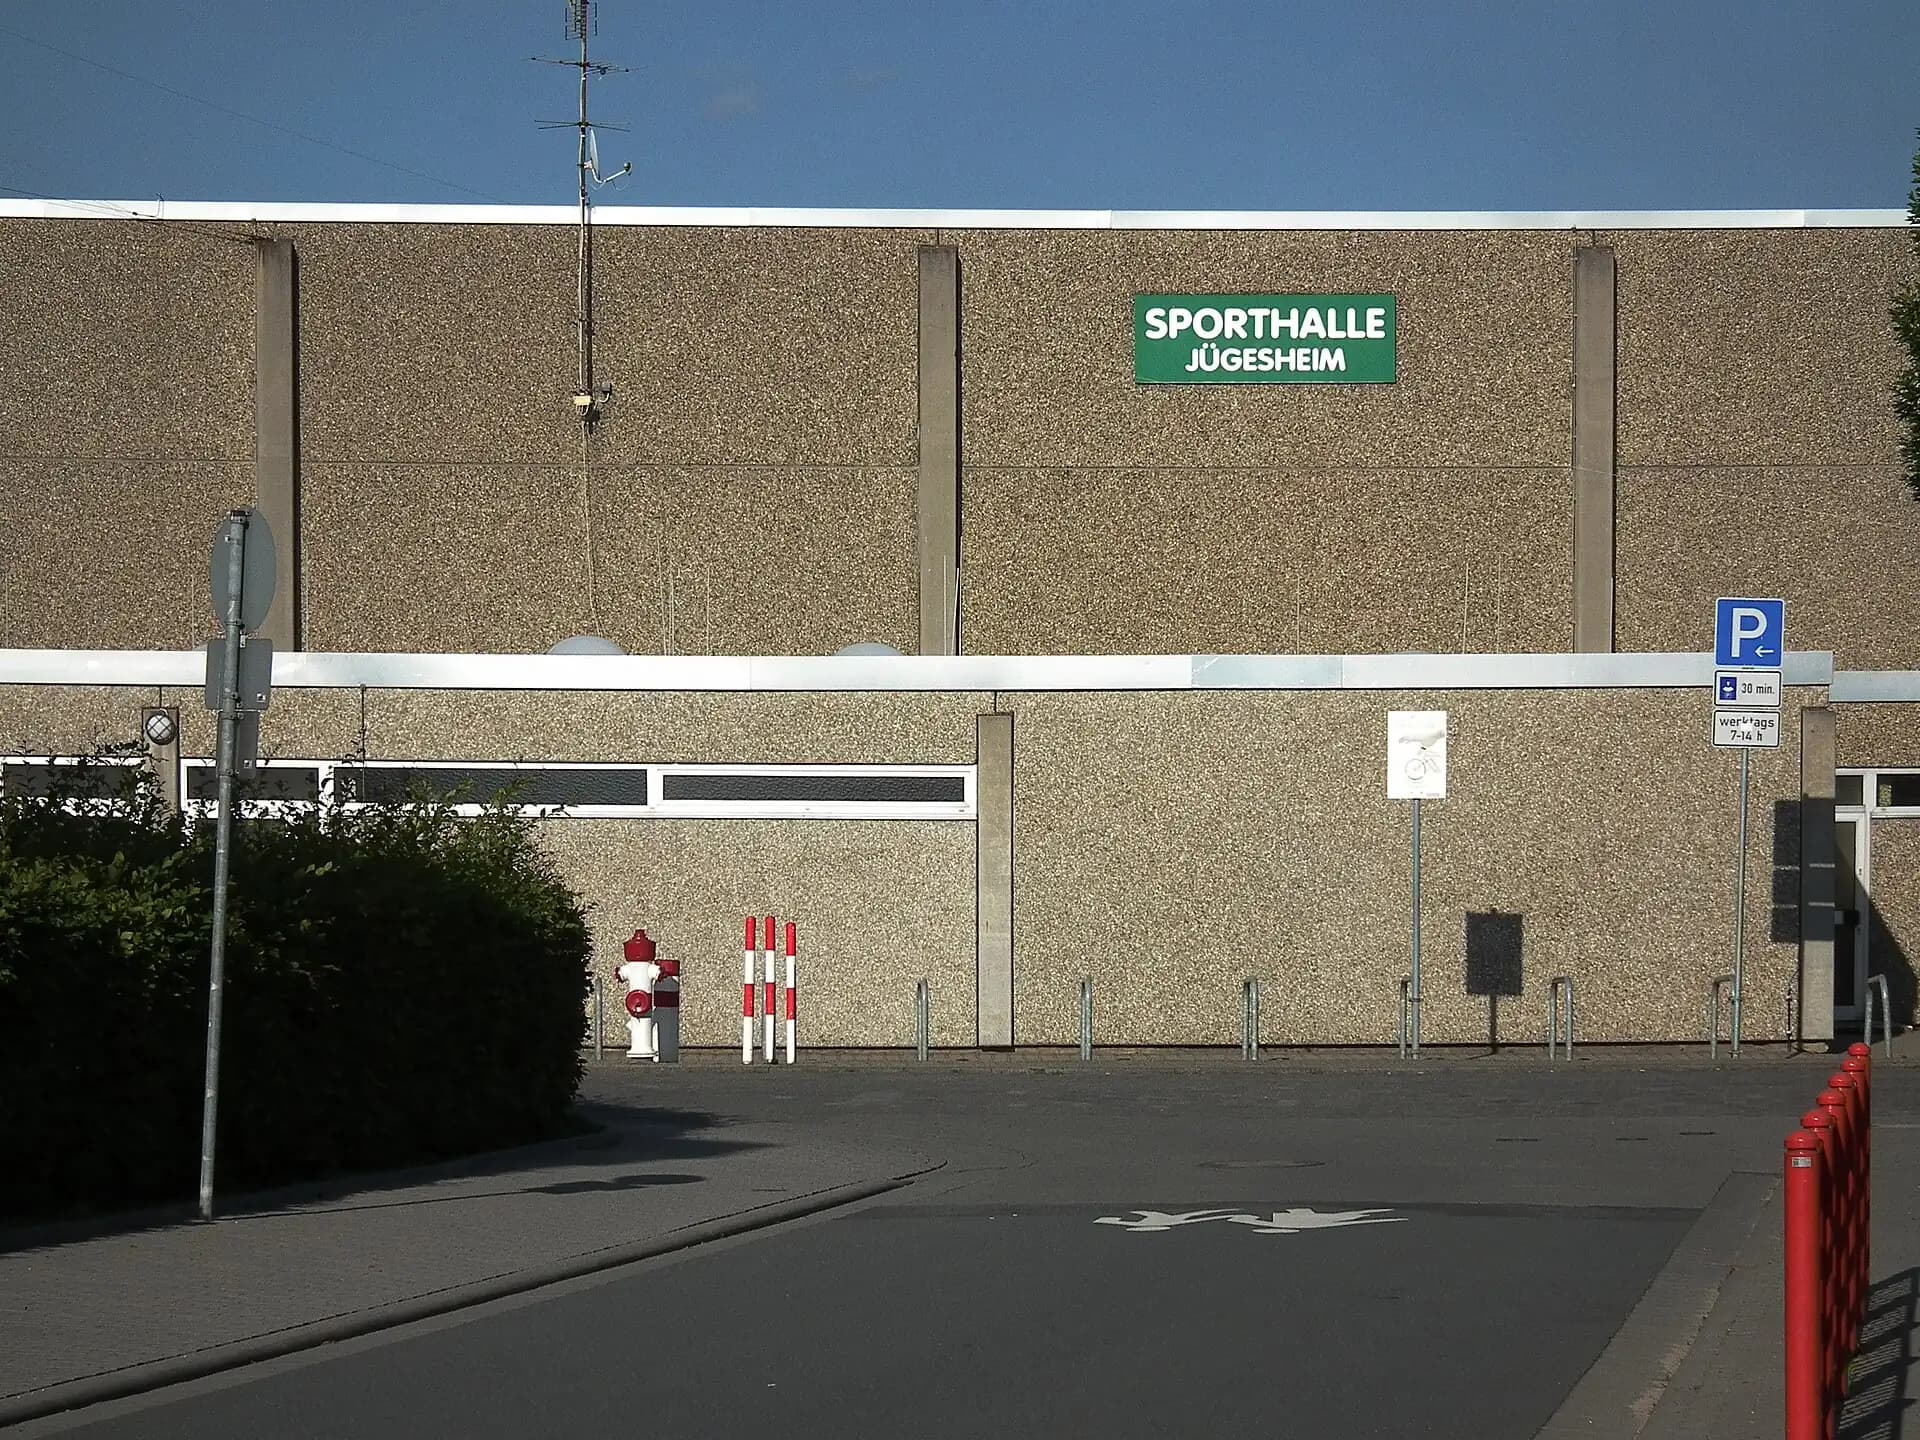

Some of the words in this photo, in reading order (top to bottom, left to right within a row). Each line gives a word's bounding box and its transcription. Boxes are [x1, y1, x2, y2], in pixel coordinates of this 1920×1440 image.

[1145, 308, 1385, 339] SPORTHALLE
[1185, 342, 1346, 372] JÜGESHEIM
[1731, 608, 1767, 657] P
[1741, 683, 1752, 694] 30
[1756, 684, 1775, 694] min.
[1730, 730, 1752, 741] 7-14
[1757, 731, 1764, 741] h
